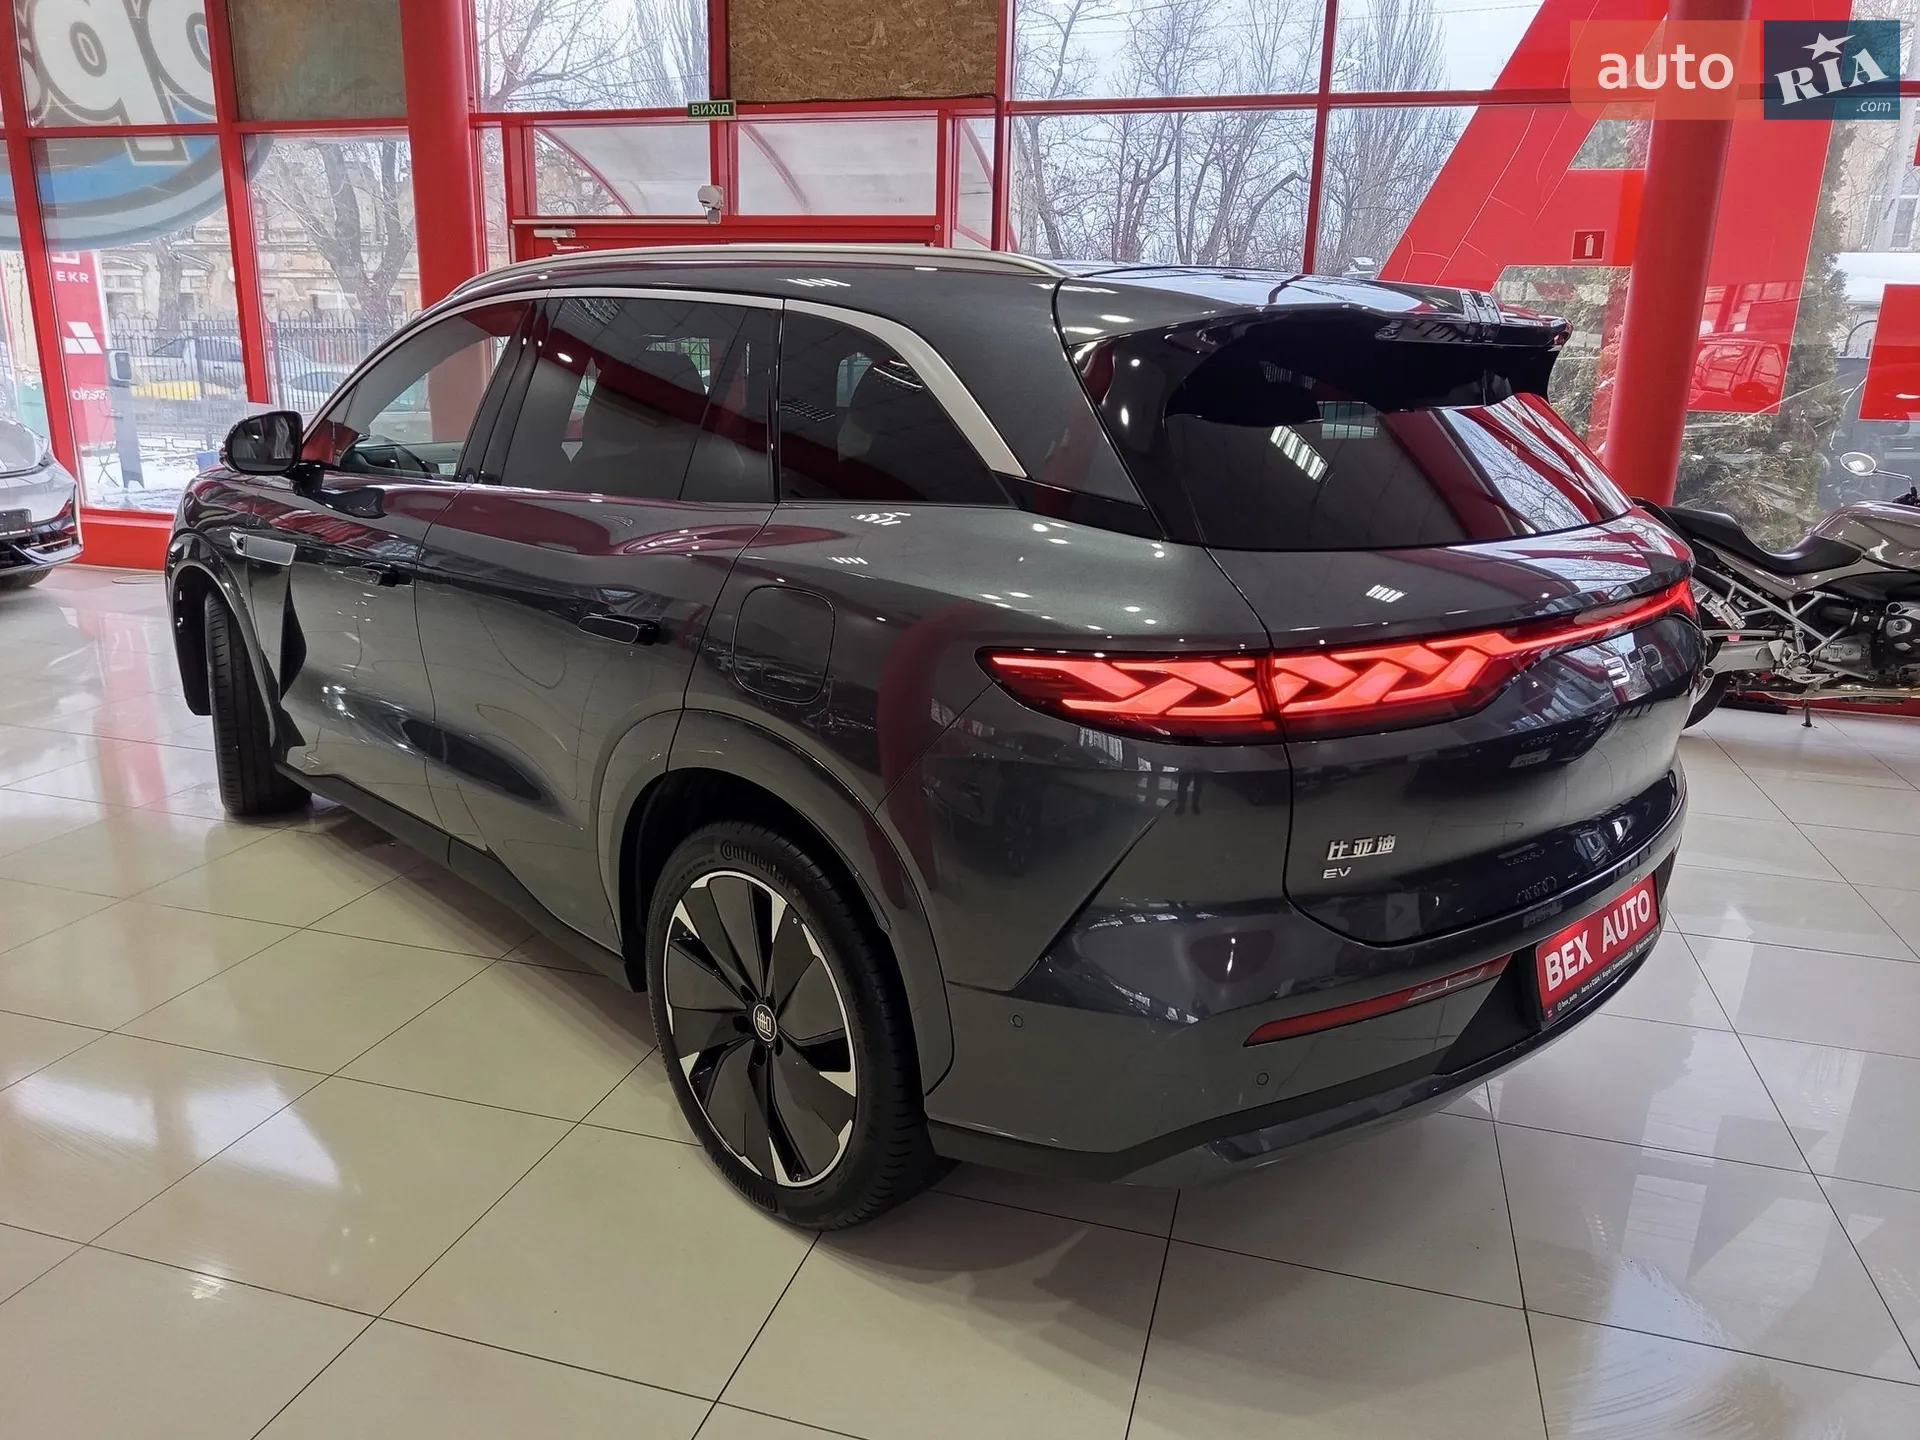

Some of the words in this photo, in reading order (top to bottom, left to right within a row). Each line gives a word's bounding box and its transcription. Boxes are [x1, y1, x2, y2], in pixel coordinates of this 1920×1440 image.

[691, 103, 730, 116] ВИХІД
[56, 270, 89, 283] EKR
[1327, 835, 1396, 861] 比亚迪
[719, 839, 791, 889] Continental
[1323, 867, 1352, 879] EV
[1544, 929, 1593, 992] BEX
[1602, 889, 1651, 954] AUTO
